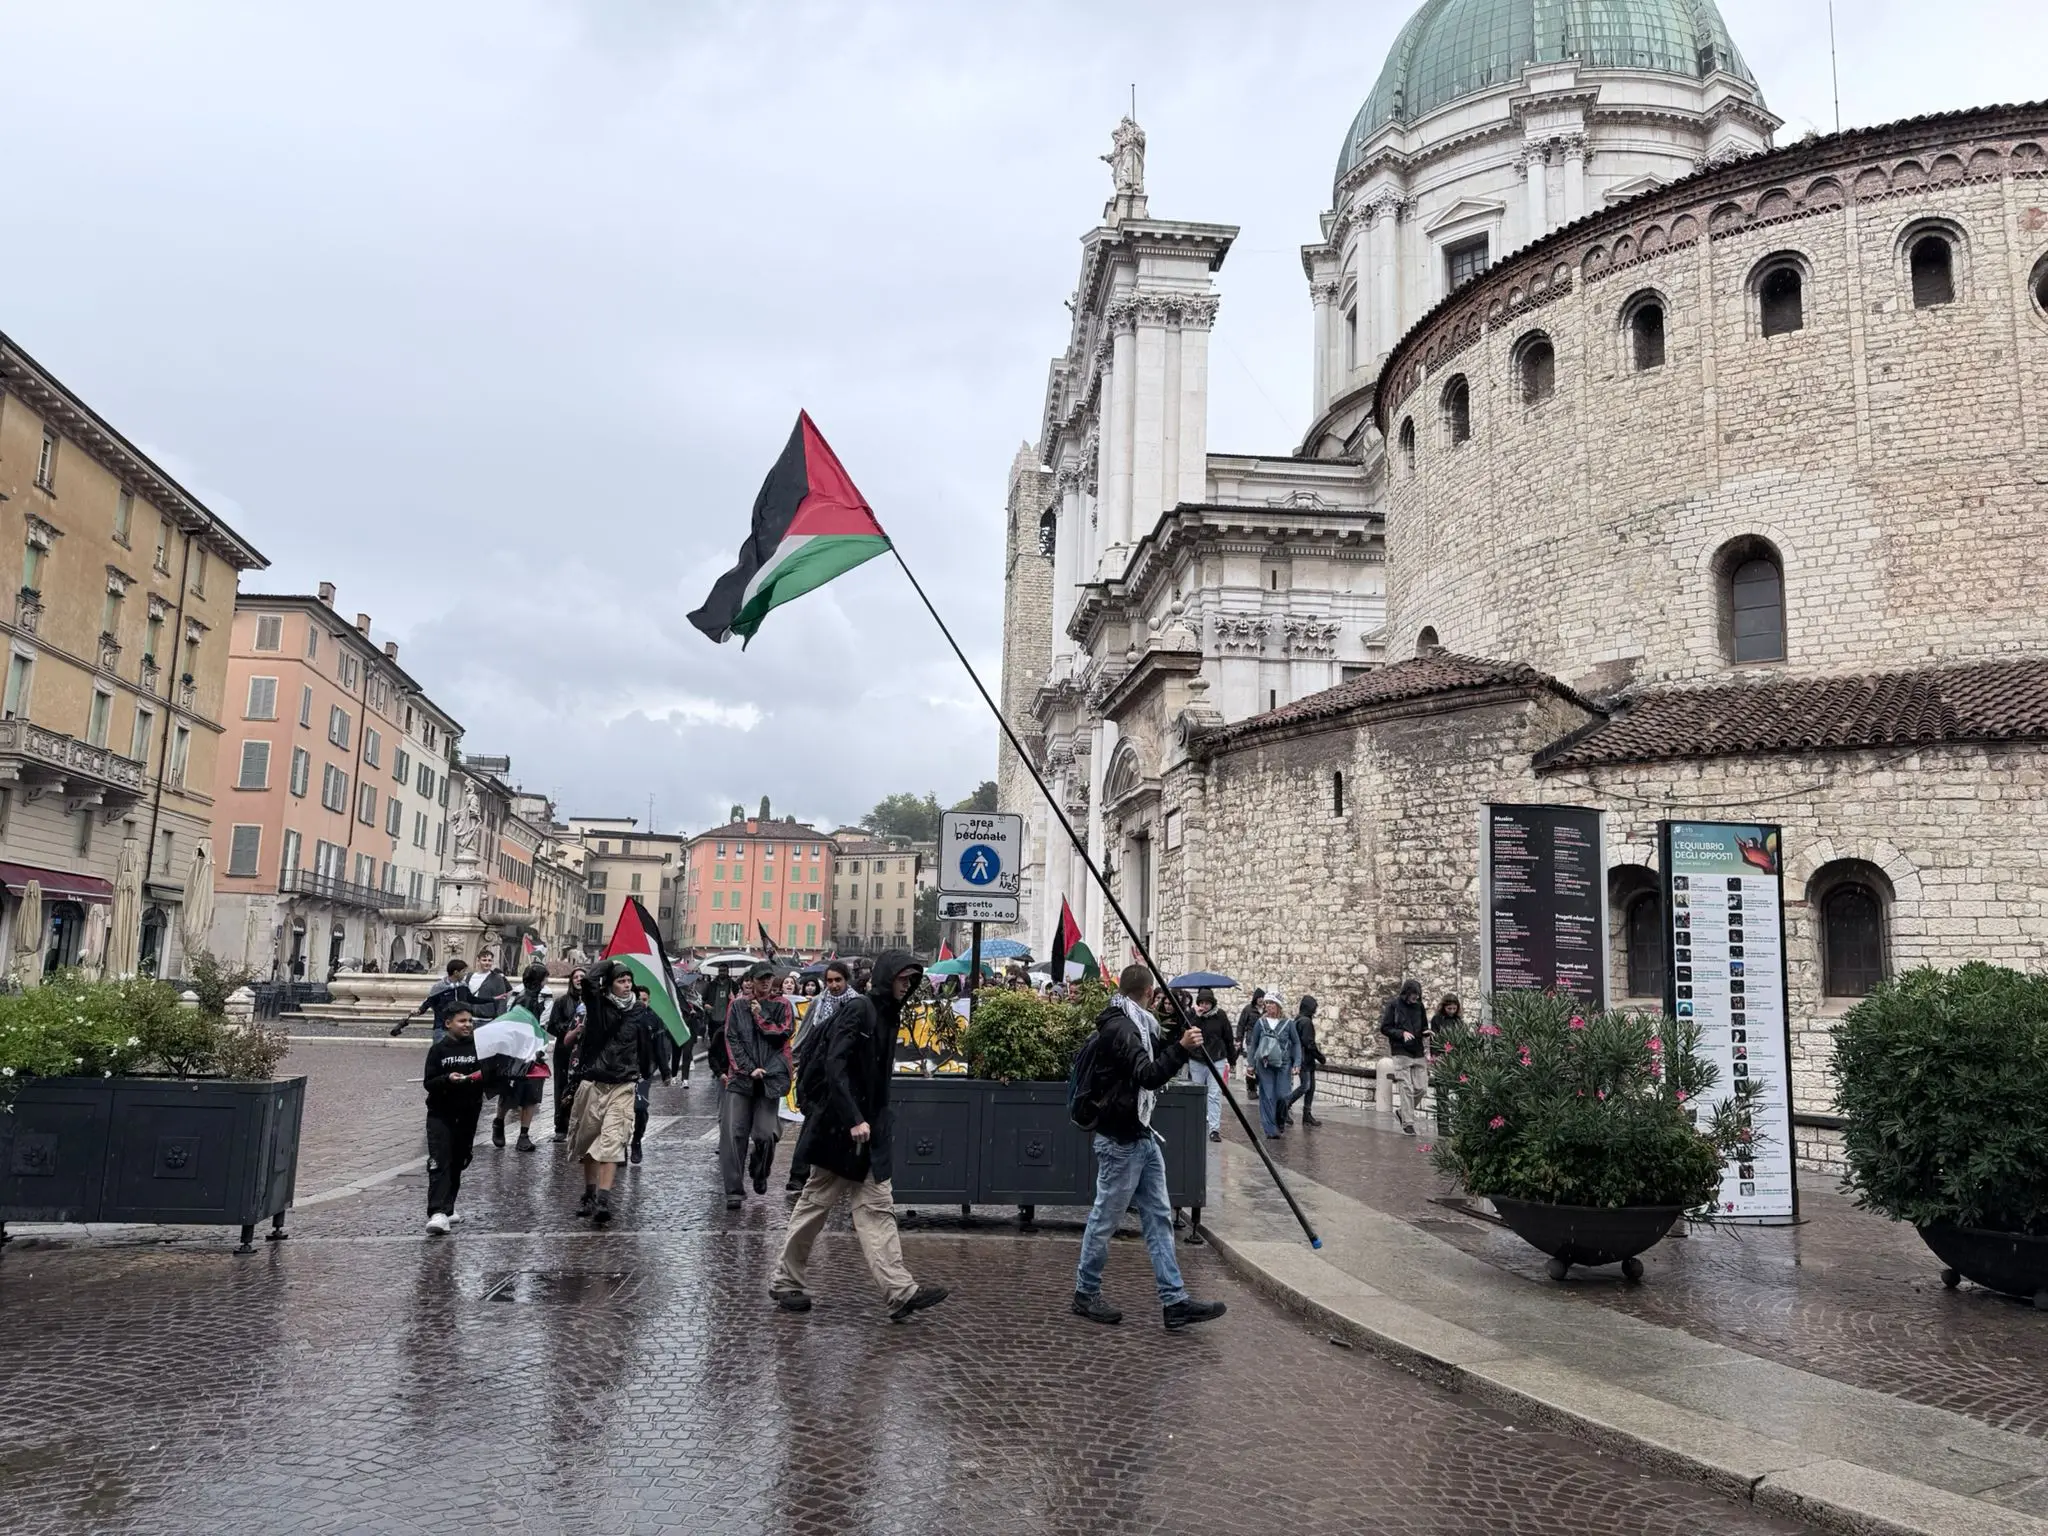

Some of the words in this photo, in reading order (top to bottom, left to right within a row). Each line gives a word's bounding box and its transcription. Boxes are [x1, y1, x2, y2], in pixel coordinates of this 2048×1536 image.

[969, 819, 994, 828] area
[955, 831, 1007, 842] pedonale
[1674, 841, 1725, 851] L'EQUILIBRIO
[1674, 850, 1698, 860] DEGLI
[1698, 851, 1733, 861] OPPOSTI
[961, 901, 993, 909] ccetto
